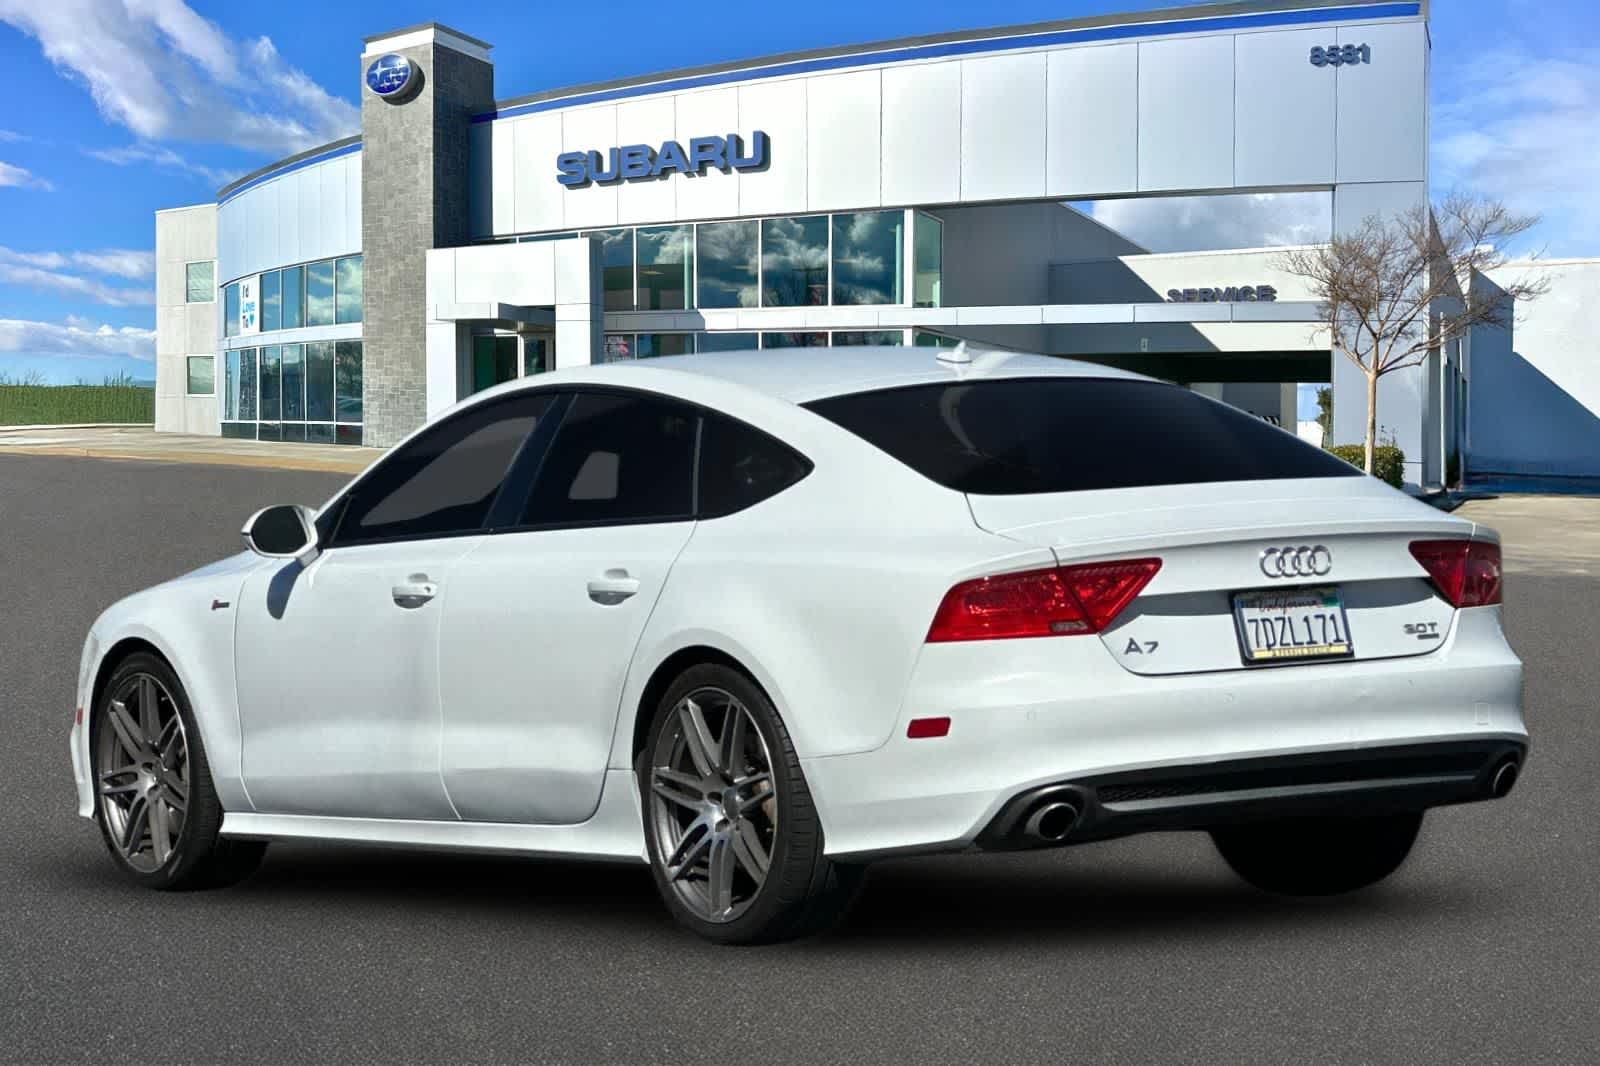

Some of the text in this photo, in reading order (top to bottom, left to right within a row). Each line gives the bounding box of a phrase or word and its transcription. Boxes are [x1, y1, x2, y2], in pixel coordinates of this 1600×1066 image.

[557, 130, 770, 188] SUBARU
[1166, 285, 1277, 302] SERVICE
[1247, 614, 1345, 648] 7DZL171
[1124, 637, 1159, 655] A7
